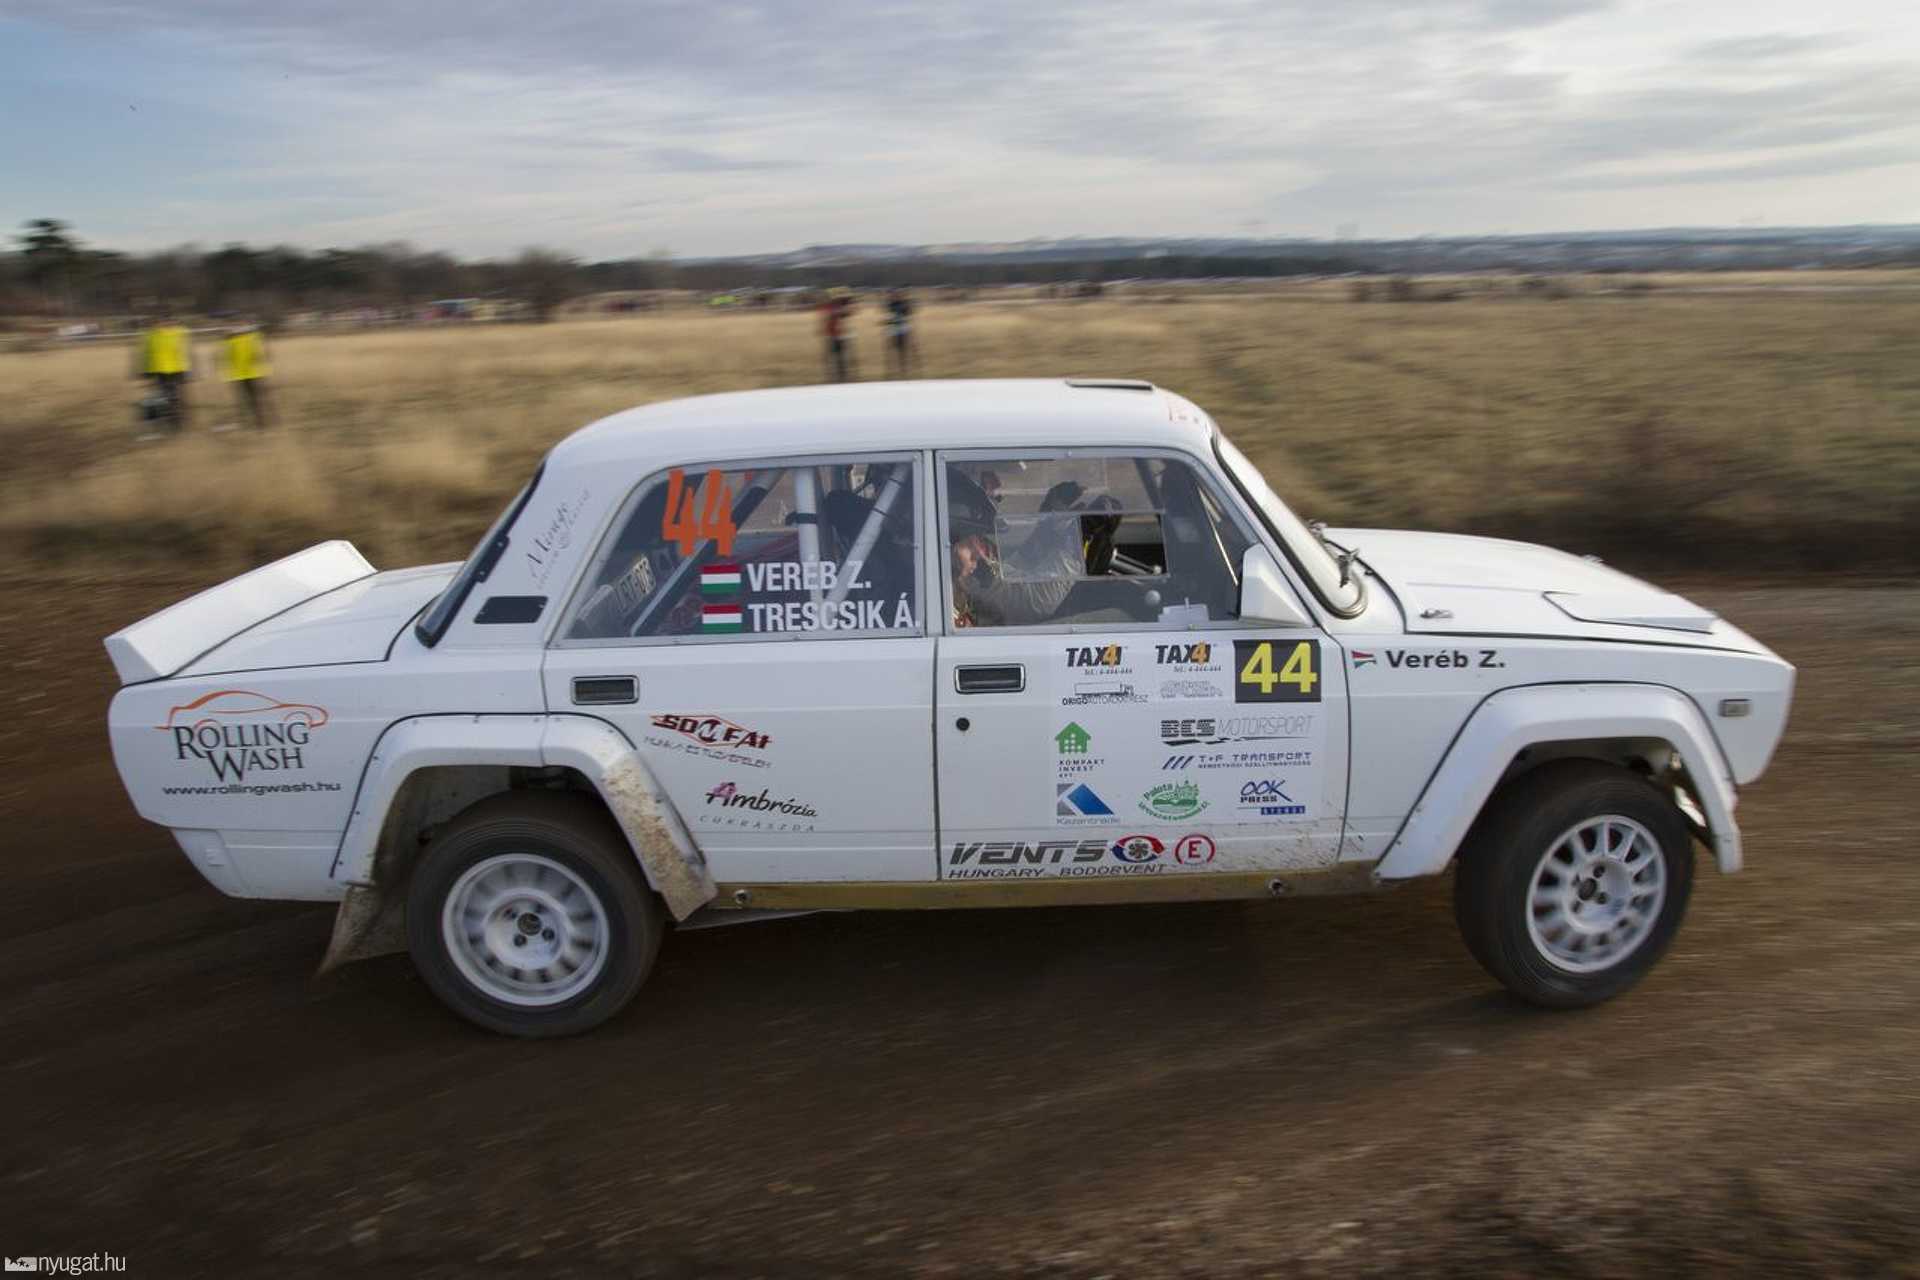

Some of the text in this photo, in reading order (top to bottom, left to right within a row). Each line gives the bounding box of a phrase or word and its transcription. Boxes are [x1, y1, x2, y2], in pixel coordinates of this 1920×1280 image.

[662, 469, 737, 557] 44
[847, 560, 872, 589] Z.
[747, 600, 886, 632] TRESCSIK
[1240, 642, 1318, 694] 44
[1386, 650, 1505, 668] Veréb Z.
[173, 721, 309, 760] ROLLING
[206, 747, 304, 782] WASH
[1232, 752, 1312, 761] TRANSPORT
[162, 782, 342, 796] www.rollingwash.hu
[705, 782, 818, 817] Ambrózia
[950, 840, 1108, 864] VENTS
[1188, 840, 1202, 858] E
[948, 864, 1167, 878] HUNGARY BODORVENT
